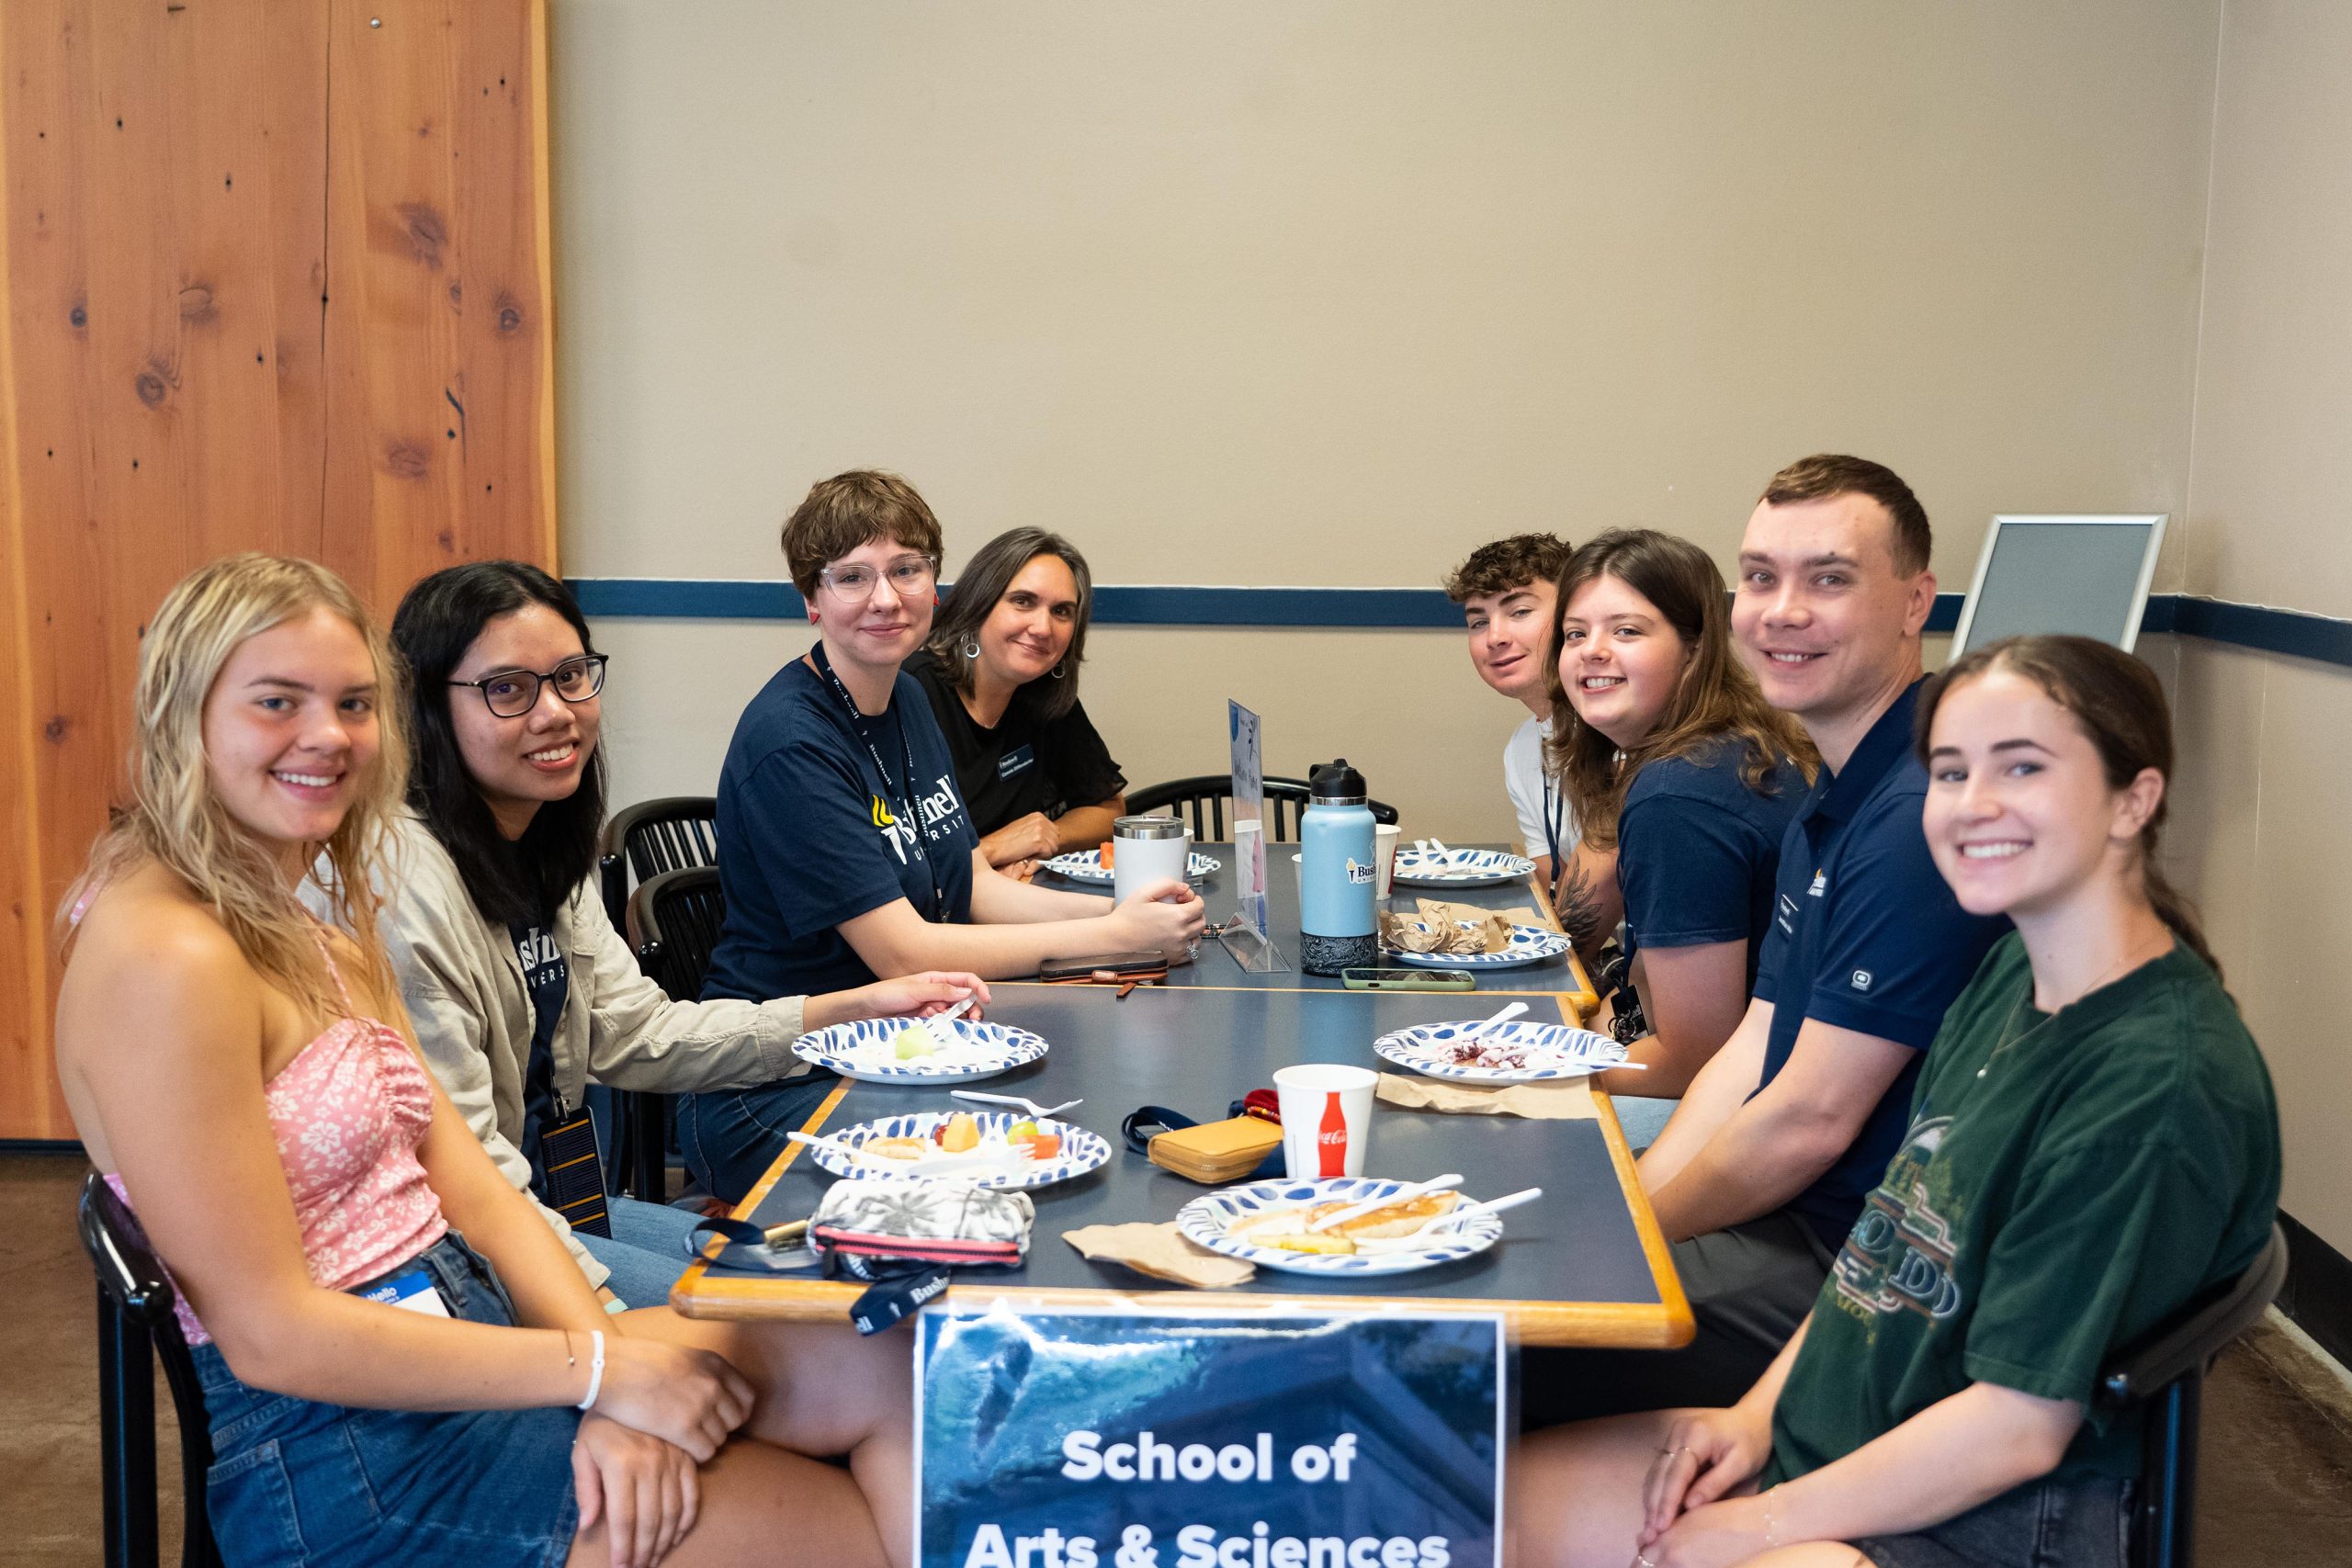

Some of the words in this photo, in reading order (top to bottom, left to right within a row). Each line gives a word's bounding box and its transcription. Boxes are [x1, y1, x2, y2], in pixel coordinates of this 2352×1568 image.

[1061, 1429, 1272, 1482] School
[1291, 1433, 1358, 1482] of
[964, 1523, 1098, 1568] Arts
[1114, 1524, 1159, 1568] &
[1176, 1521, 1450, 1568] Sciences
